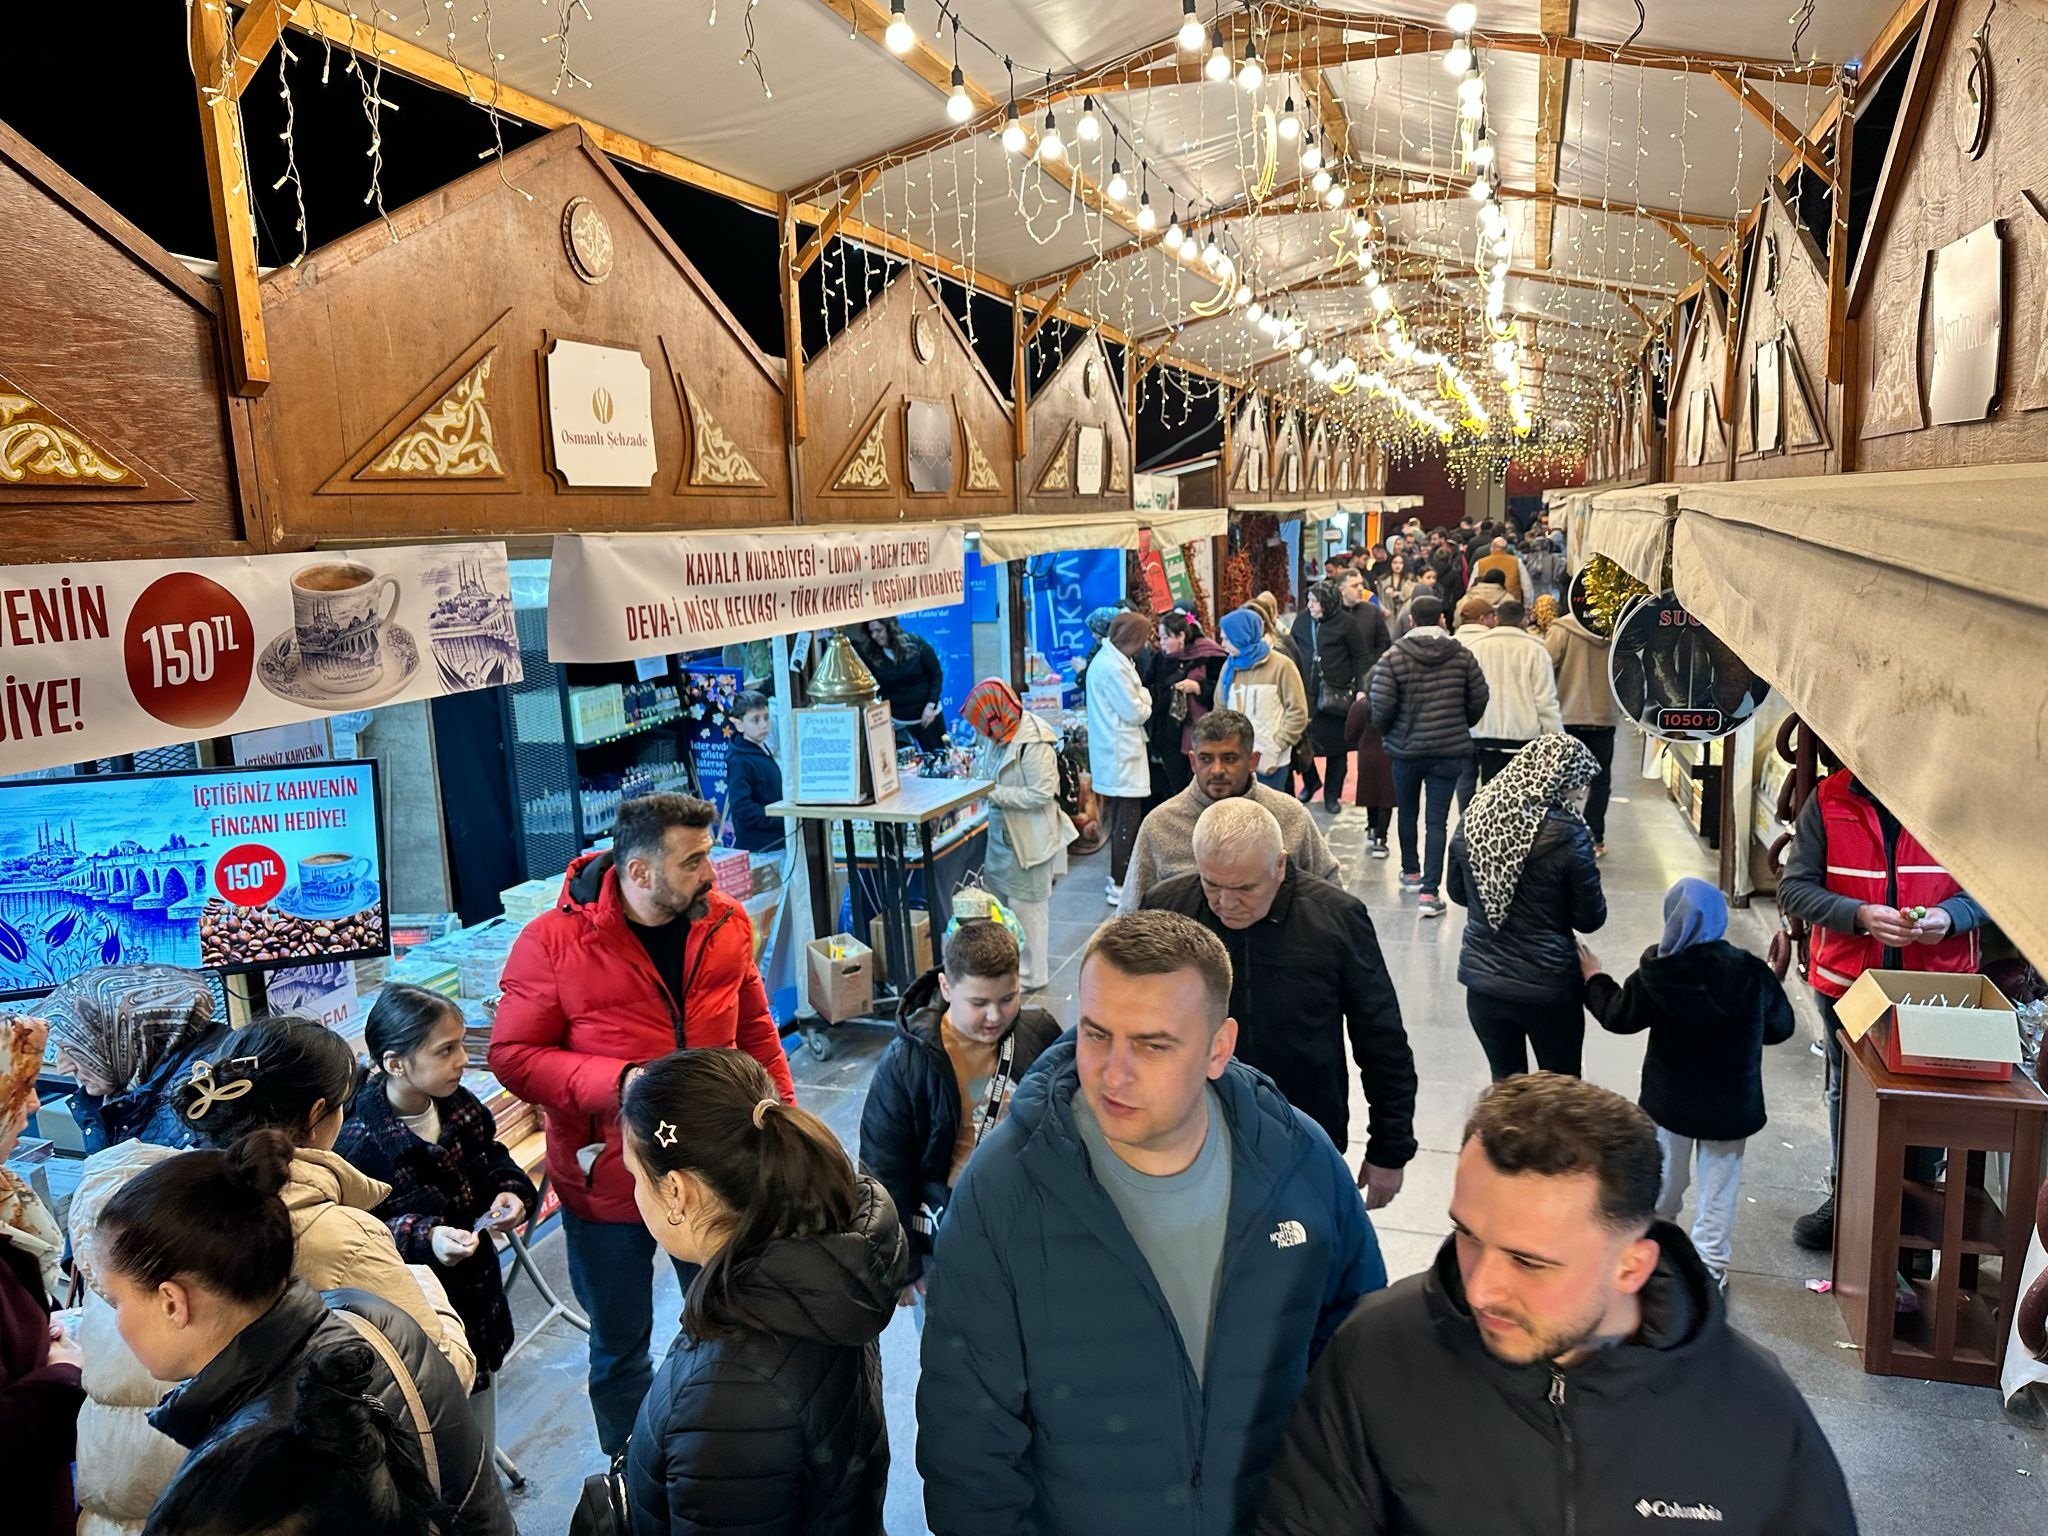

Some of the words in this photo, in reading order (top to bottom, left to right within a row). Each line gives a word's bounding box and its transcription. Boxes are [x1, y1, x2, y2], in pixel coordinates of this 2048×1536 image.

[561, 429, 604, 446] Osmanlı
[607, 432, 648, 449] Şehzade
[686, 552, 741, 586] KAVALA
[746, 544, 816, 582] KURABİYESİ
[828, 546, 862, 574] LOKUM
[870, 543, 898, 570] BADEM
[901, 537, 930, 567] EZMESİ
[0, 577, 109, 648] ENİN
[626, 597, 683, 641] DEVA-İ
[684, 594, 723, 633] MİSK
[724, 592, 778, 627] HELVASI
[790, 585, 819, 618] TÜRK
[822, 578, 864, 613] KAHVESİ
[872, 574, 918, 608] HOŞGÜVAR
[0, 674, 84, 743] İYE!
[1663, 714, 1703, 727] 1050
[284, 743, 324, 764] KAHVENİN
[711, 742, 728, 751] evd
[193, 780, 272, 810] İÇTİĞİNİZ
[276, 775, 358, 801] KAHVENİN
[211, 814, 280, 837] FİNCANI
[285, 808, 347, 831] HEDİYE!
[992, 1074, 1006, 1102] PUMA
[1652, 1500, 1723, 1521] Columbia
